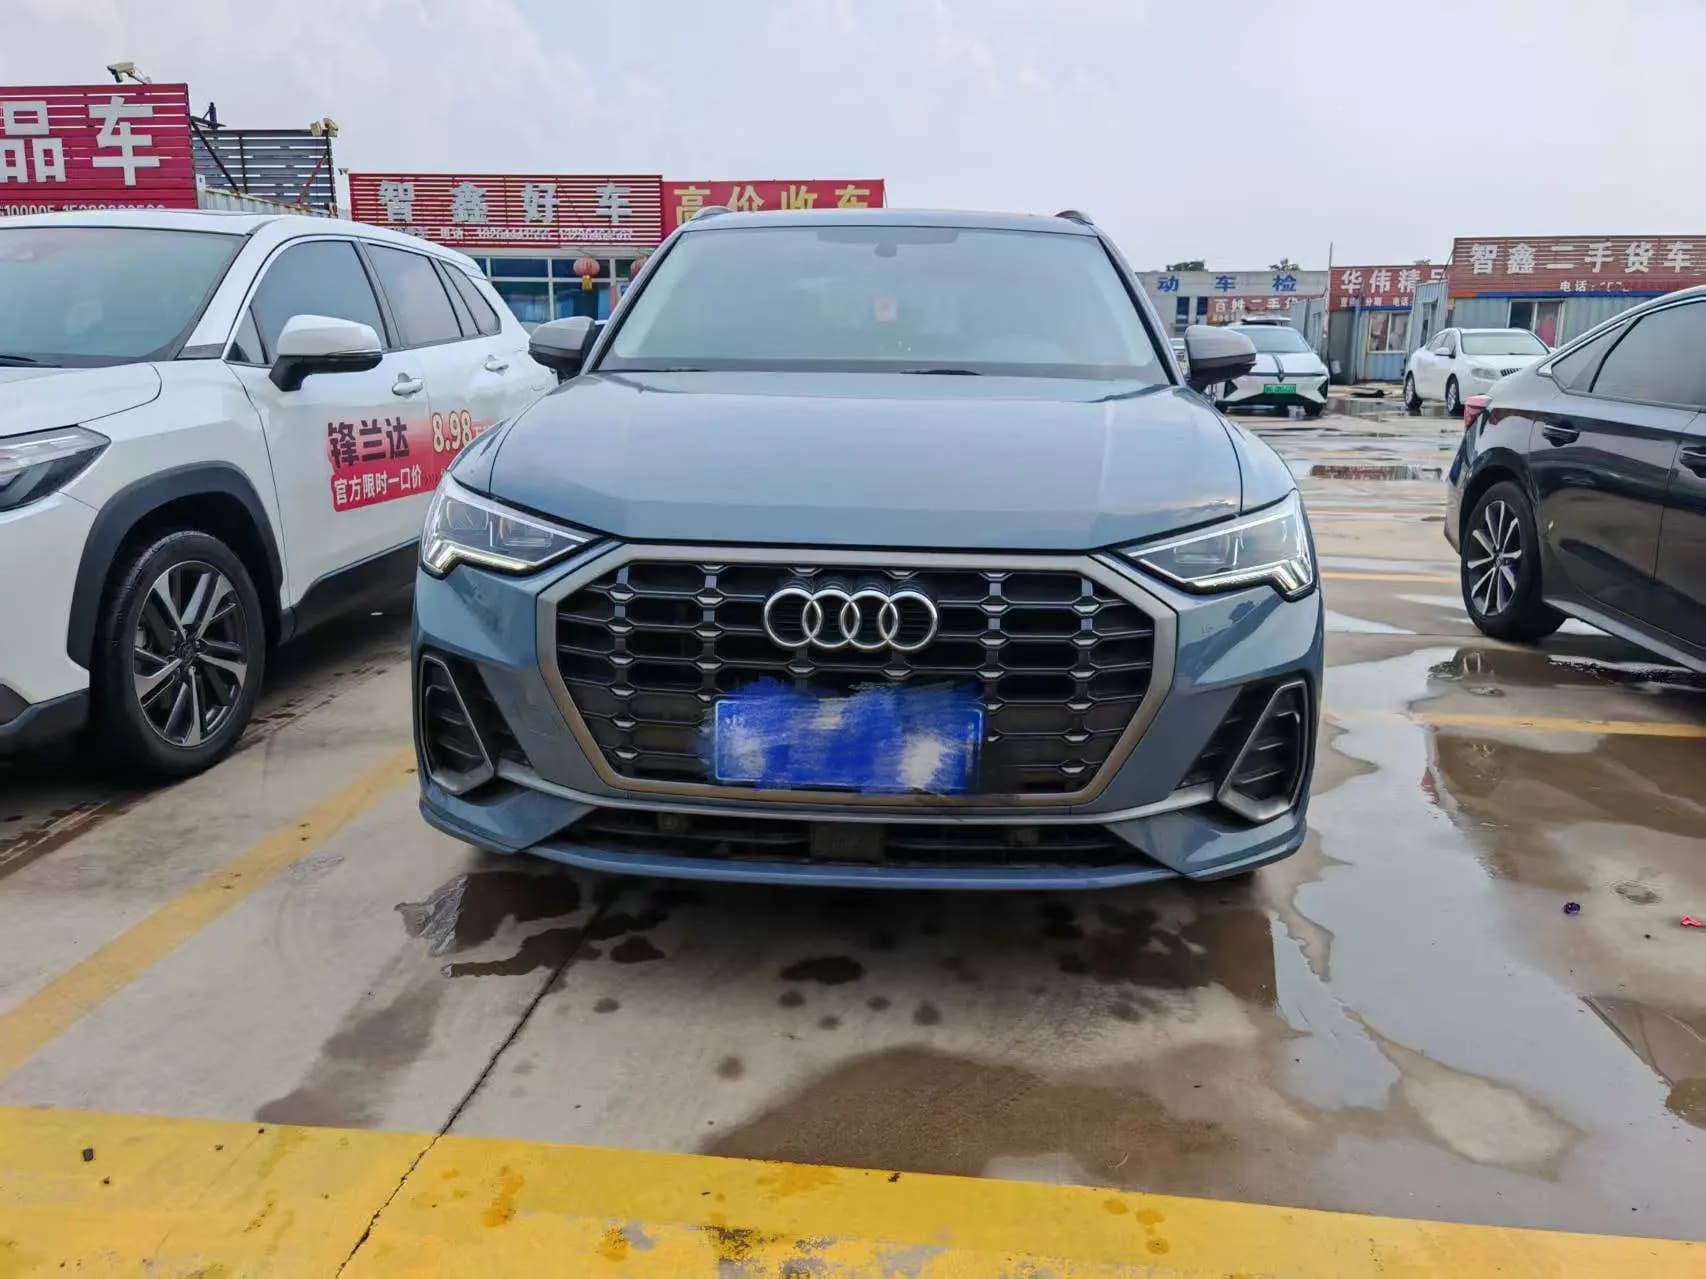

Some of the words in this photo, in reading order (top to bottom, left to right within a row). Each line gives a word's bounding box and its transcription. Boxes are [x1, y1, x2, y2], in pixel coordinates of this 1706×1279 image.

[0, 96, 160, 186] 品车
[377, 180, 633, 224] 智鑫好车
[1470, 241, 1695, 274] 智鑫二手货车
[1157, 274, 1297, 292] 动车检
[327, 417, 410, 468] 锋兰达
[432, 409, 472, 453] 8.98
[333, 464, 423, 504] 官方限时一口价
